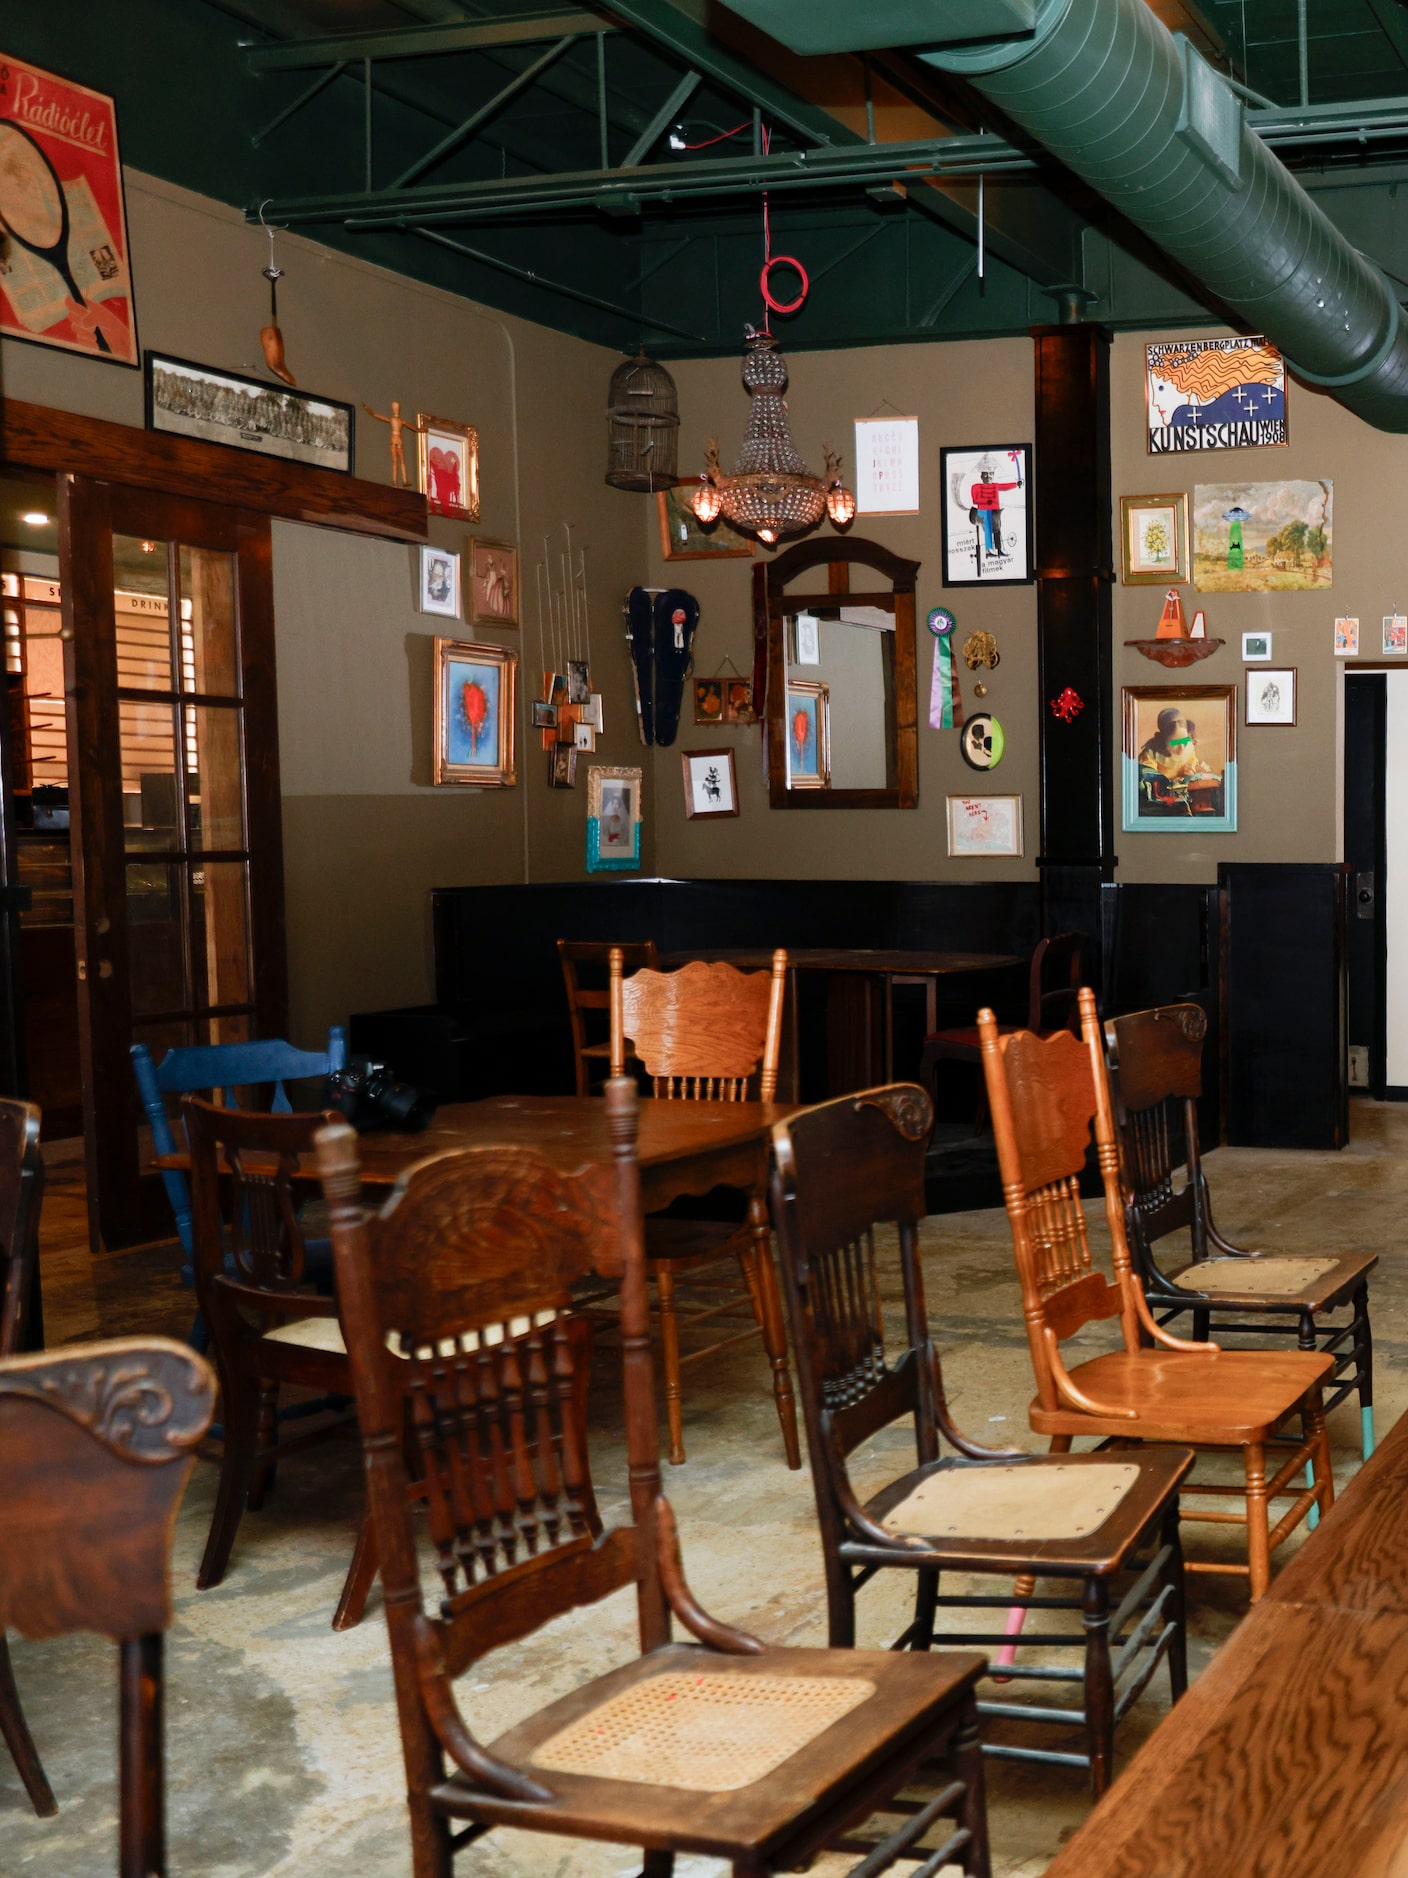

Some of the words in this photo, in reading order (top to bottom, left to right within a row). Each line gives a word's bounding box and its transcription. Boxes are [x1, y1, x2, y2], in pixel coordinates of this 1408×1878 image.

[1148, 339, 1249, 355] SCHWARZENBERGPLATZ
[1259, 419, 1285, 433] WIEN
[1149, 421, 1259, 453] KUNSTSCHAU
[1260, 431, 1285, 445] 1908
[987, 557, 1014, 567] magyar
[982, 566, 1003, 575] filmek
